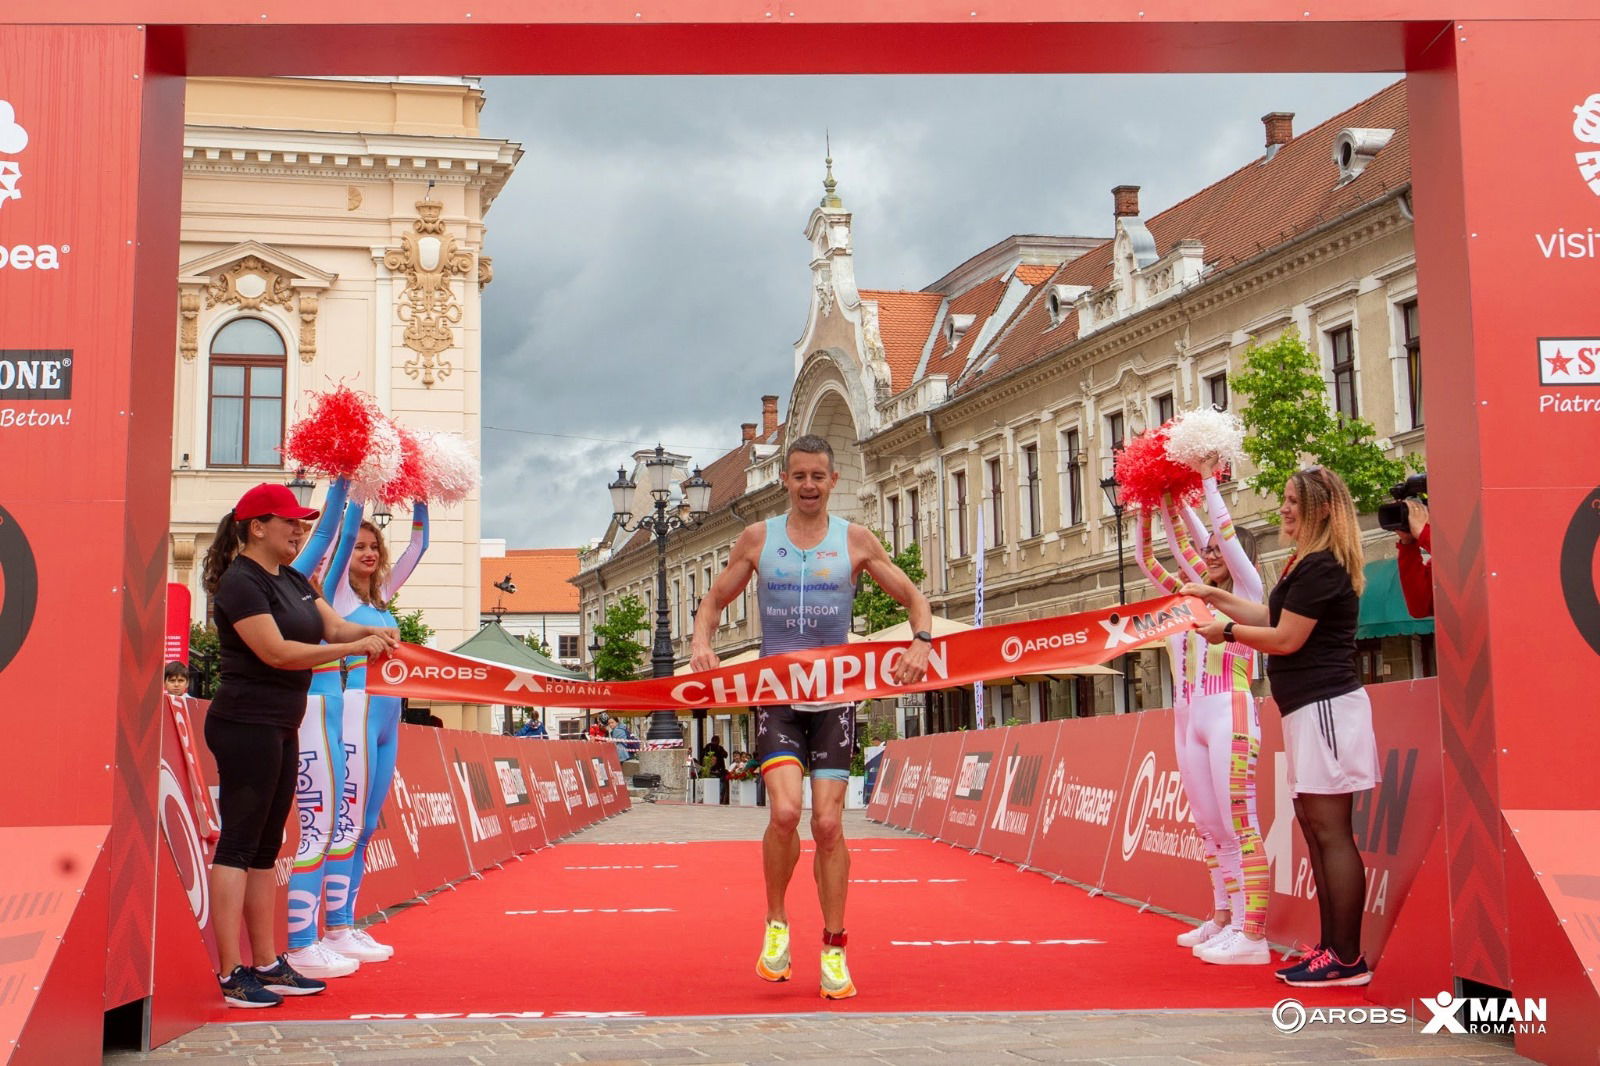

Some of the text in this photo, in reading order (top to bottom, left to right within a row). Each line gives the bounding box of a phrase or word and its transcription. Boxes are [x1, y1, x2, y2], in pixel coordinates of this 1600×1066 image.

[1535, 228, 1600, 258] visi
[767, 582, 839, 592] Unstoppable
[767, 605, 839, 616] Manu KERGOAT
[786, 618, 817, 628] ROU
[1024, 631, 1088, 652] AROBS
[409, 666, 488, 680] AROBS
[545, 684, 611, 696] ROMANIA
